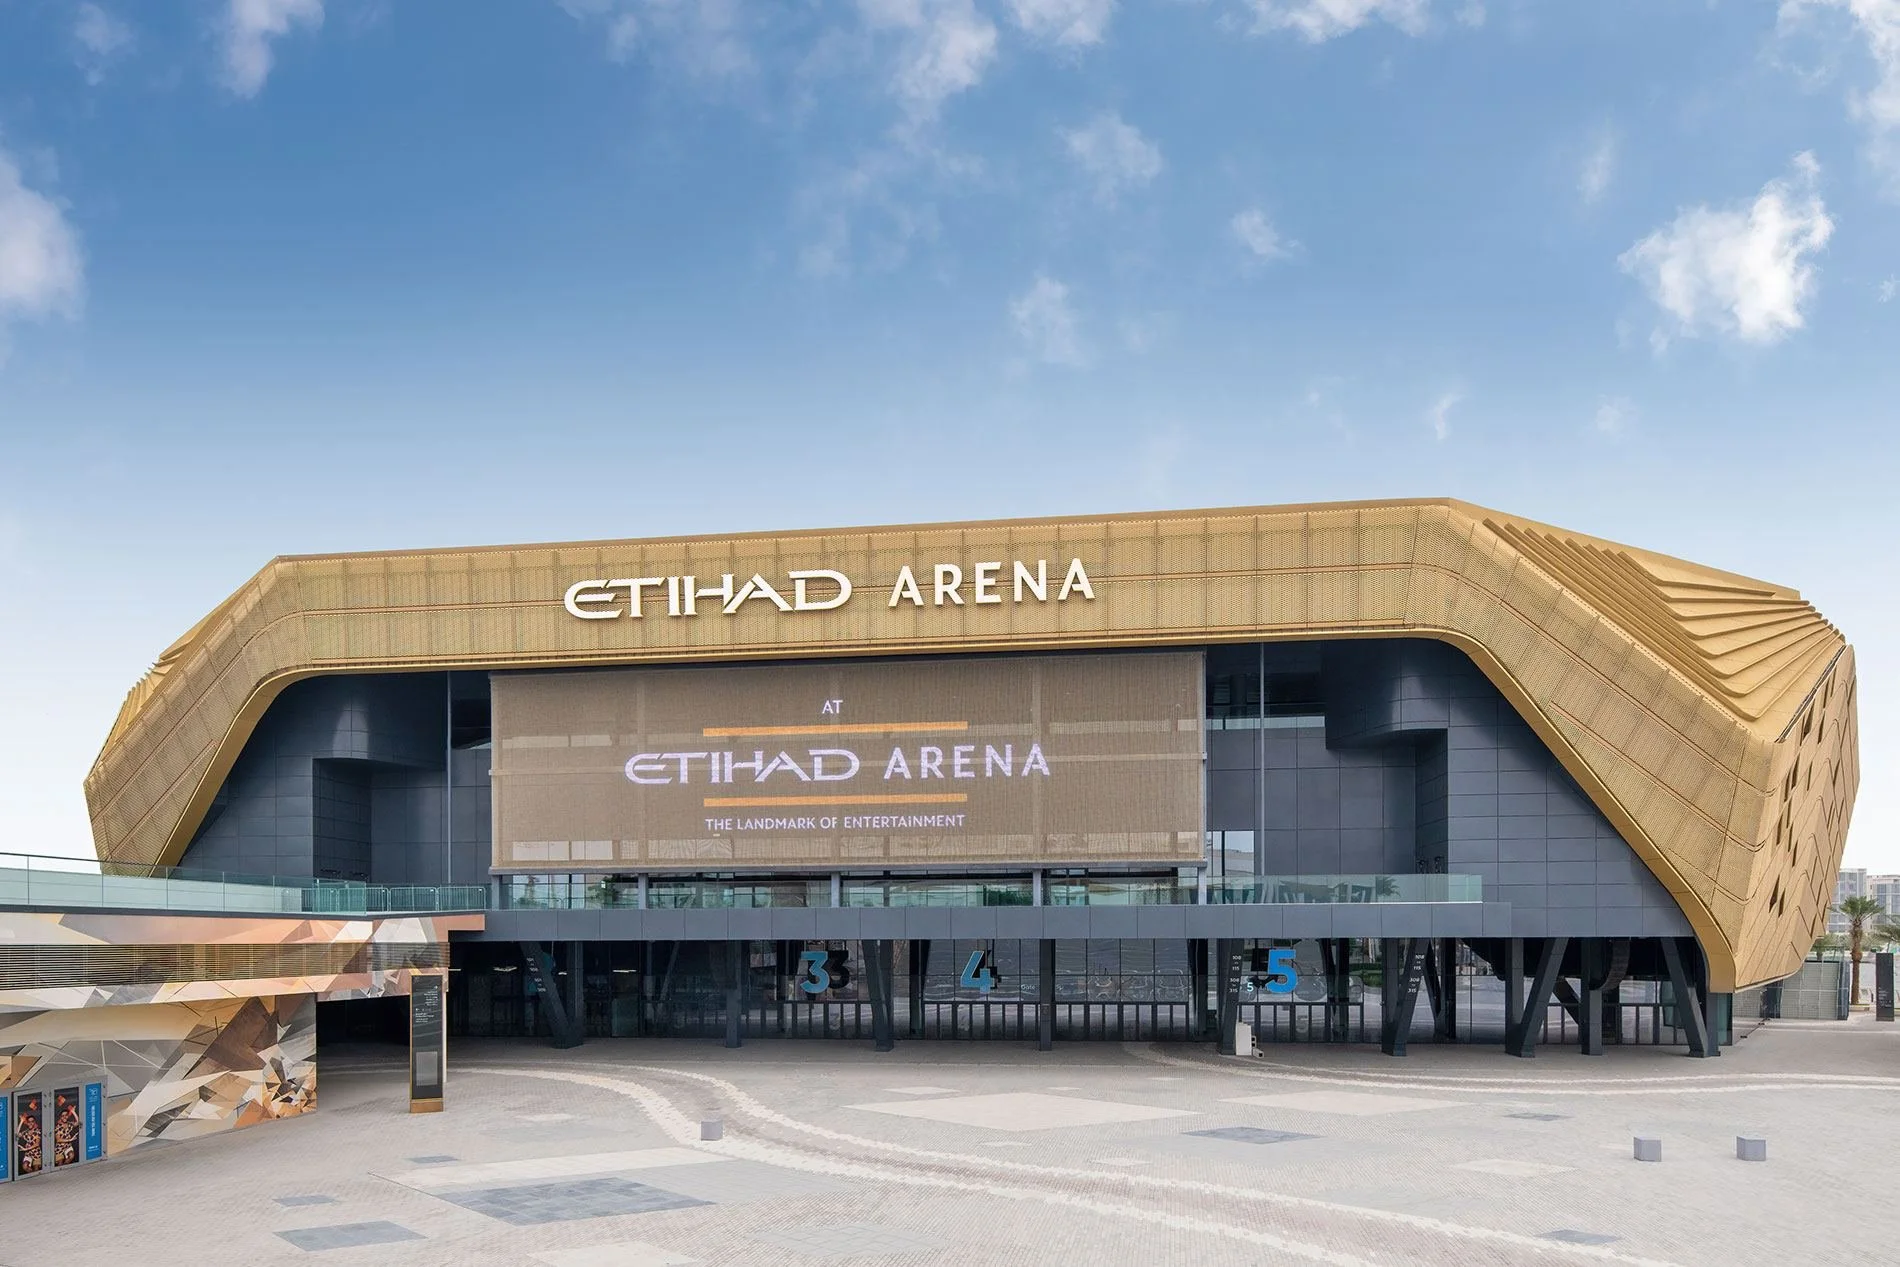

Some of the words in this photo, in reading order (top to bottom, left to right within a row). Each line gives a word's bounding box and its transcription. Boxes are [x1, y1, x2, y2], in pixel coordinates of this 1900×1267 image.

[564, 569, 853, 620] ETIHAD
[888, 557, 1096, 608] ARENA
[821, 699, 844, 715] AT
[624, 748, 860, 785] ETIHAD
[883, 743, 1051, 780] ARENA
[704, 817, 733, 831] THE
[736, 816, 816, 831] LANDMARK
[819, 816, 839, 829] OF
[799, 951, 830, 993] 3
[960, 951, 995, 994] 4
[1246, 982, 1254, 992] 5
[1265, 948, 1298, 993] 5
